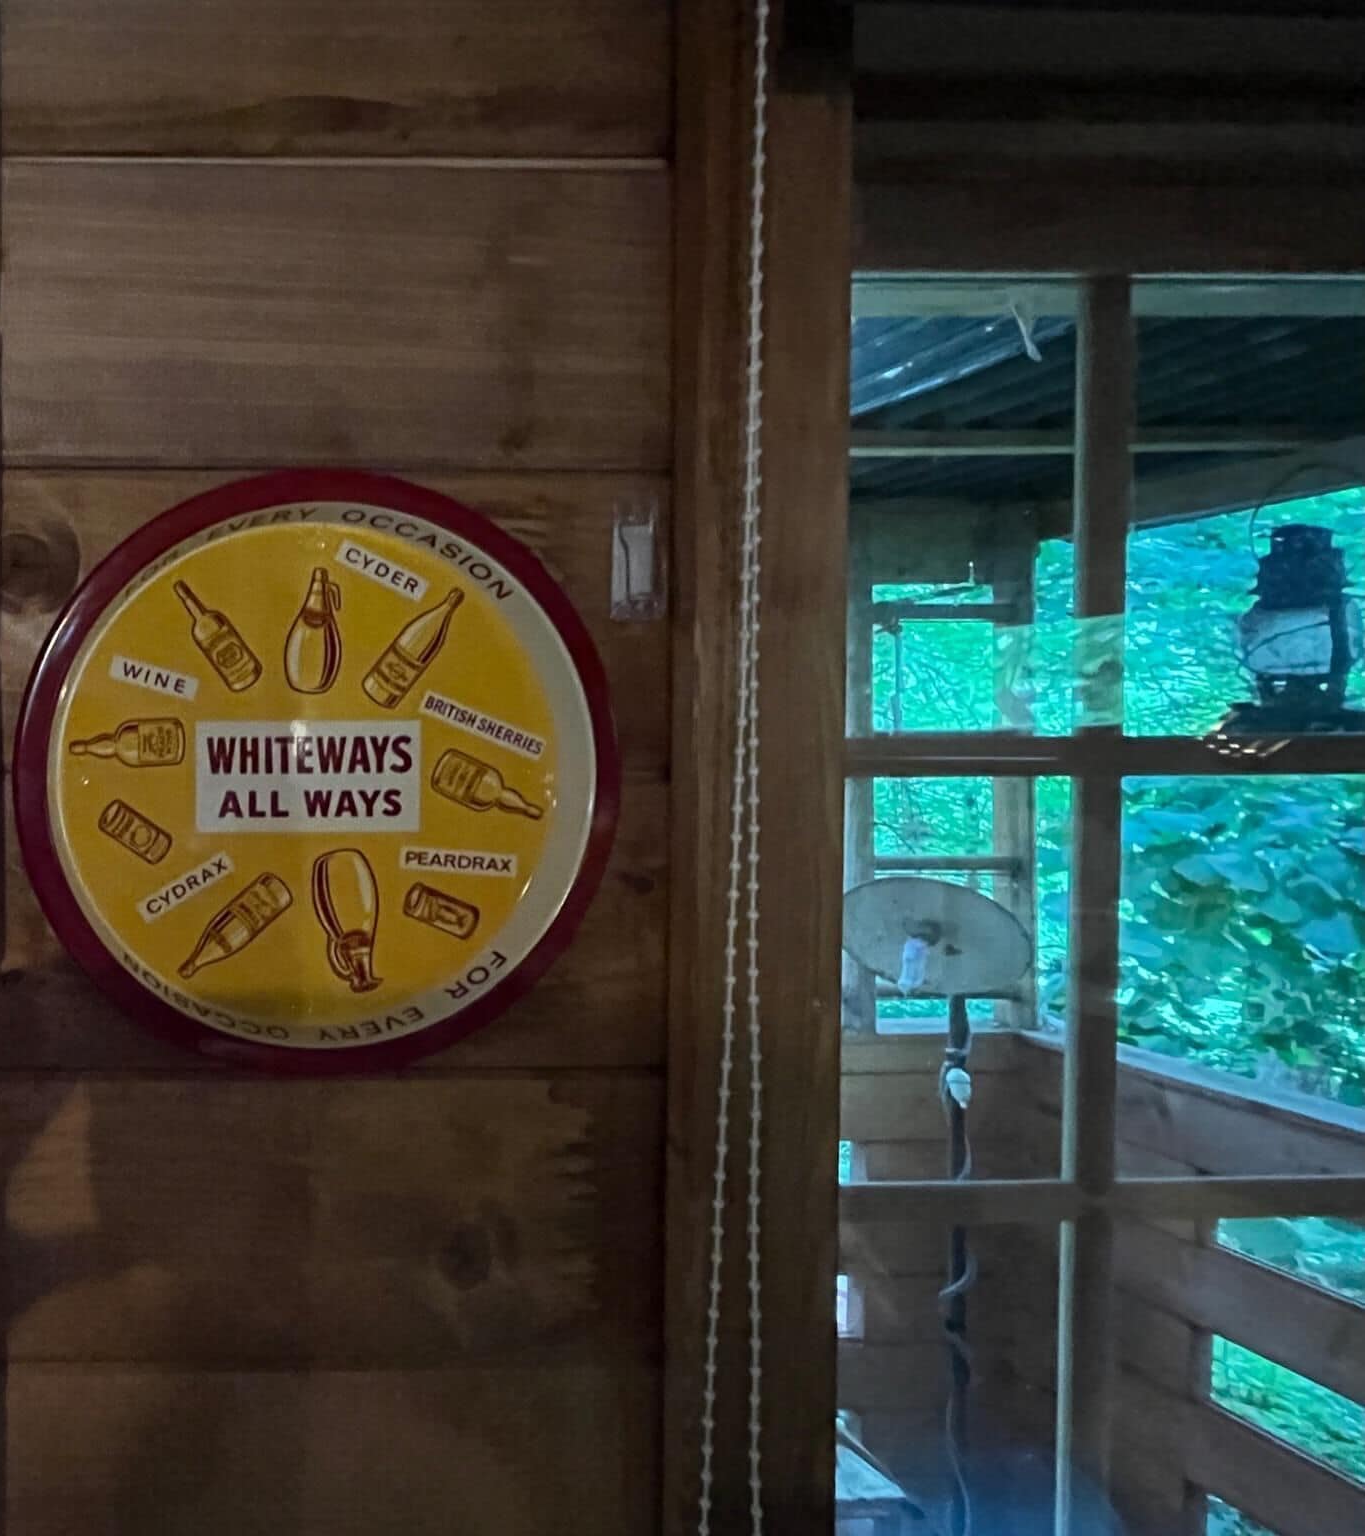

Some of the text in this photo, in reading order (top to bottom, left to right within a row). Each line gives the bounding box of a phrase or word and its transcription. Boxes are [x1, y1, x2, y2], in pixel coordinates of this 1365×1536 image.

[341, 508, 514, 601] OCCASION
[344, 546, 420, 594] CYDER
[122, 660, 187, 694] WINE
[424, 694, 544, 755] BRITISH SHERRIES
[206, 734, 413, 775] WHITEWAYS
[217, 789, 403, 819] ALL WAYS
[404, 849, 513, 873] PEARDRAX
[145, 857, 229, 915] CYDRAX
[122, 950, 508, 1042] FOR EVERY OCCASION
